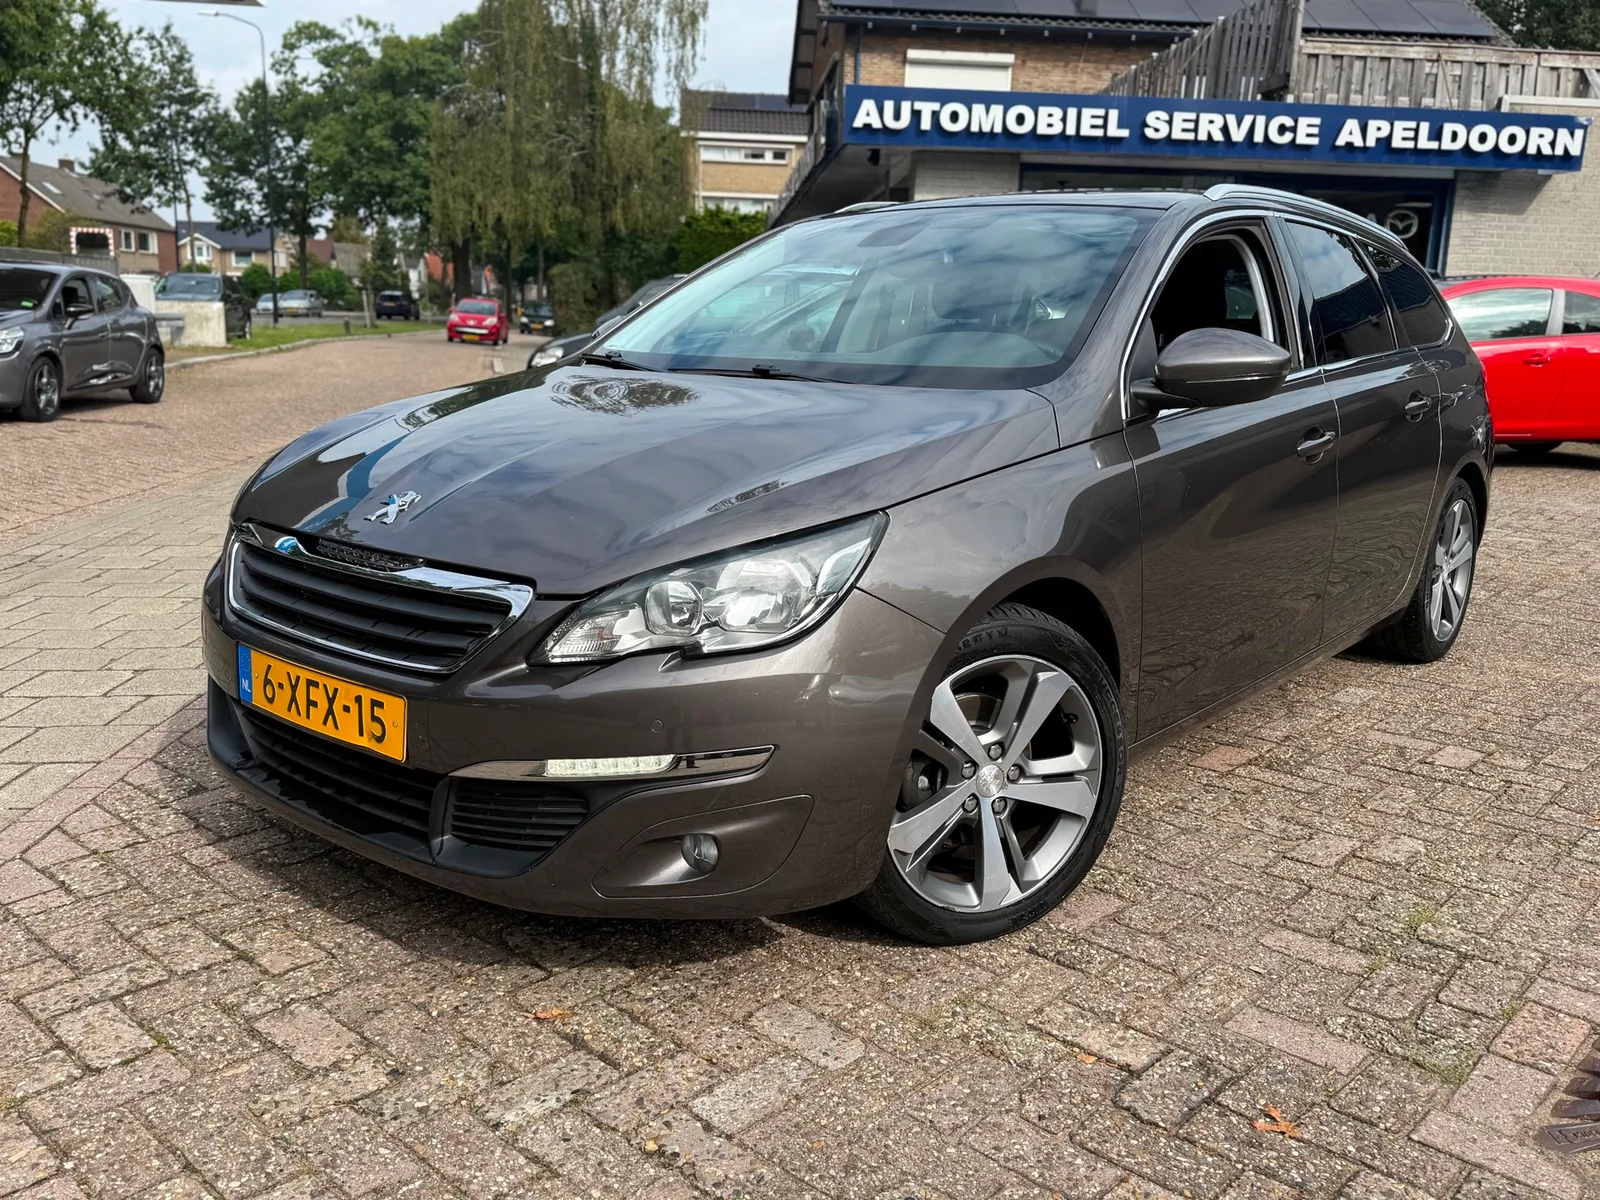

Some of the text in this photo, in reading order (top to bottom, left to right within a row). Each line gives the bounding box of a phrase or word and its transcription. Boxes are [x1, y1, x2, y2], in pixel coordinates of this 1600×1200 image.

[852, 98, 1585, 156] AUTOMOBIEL SERVICE APELDOORN
[241, 677, 251, 693] NL
[262, 664, 387, 744] 6-XFX-15
